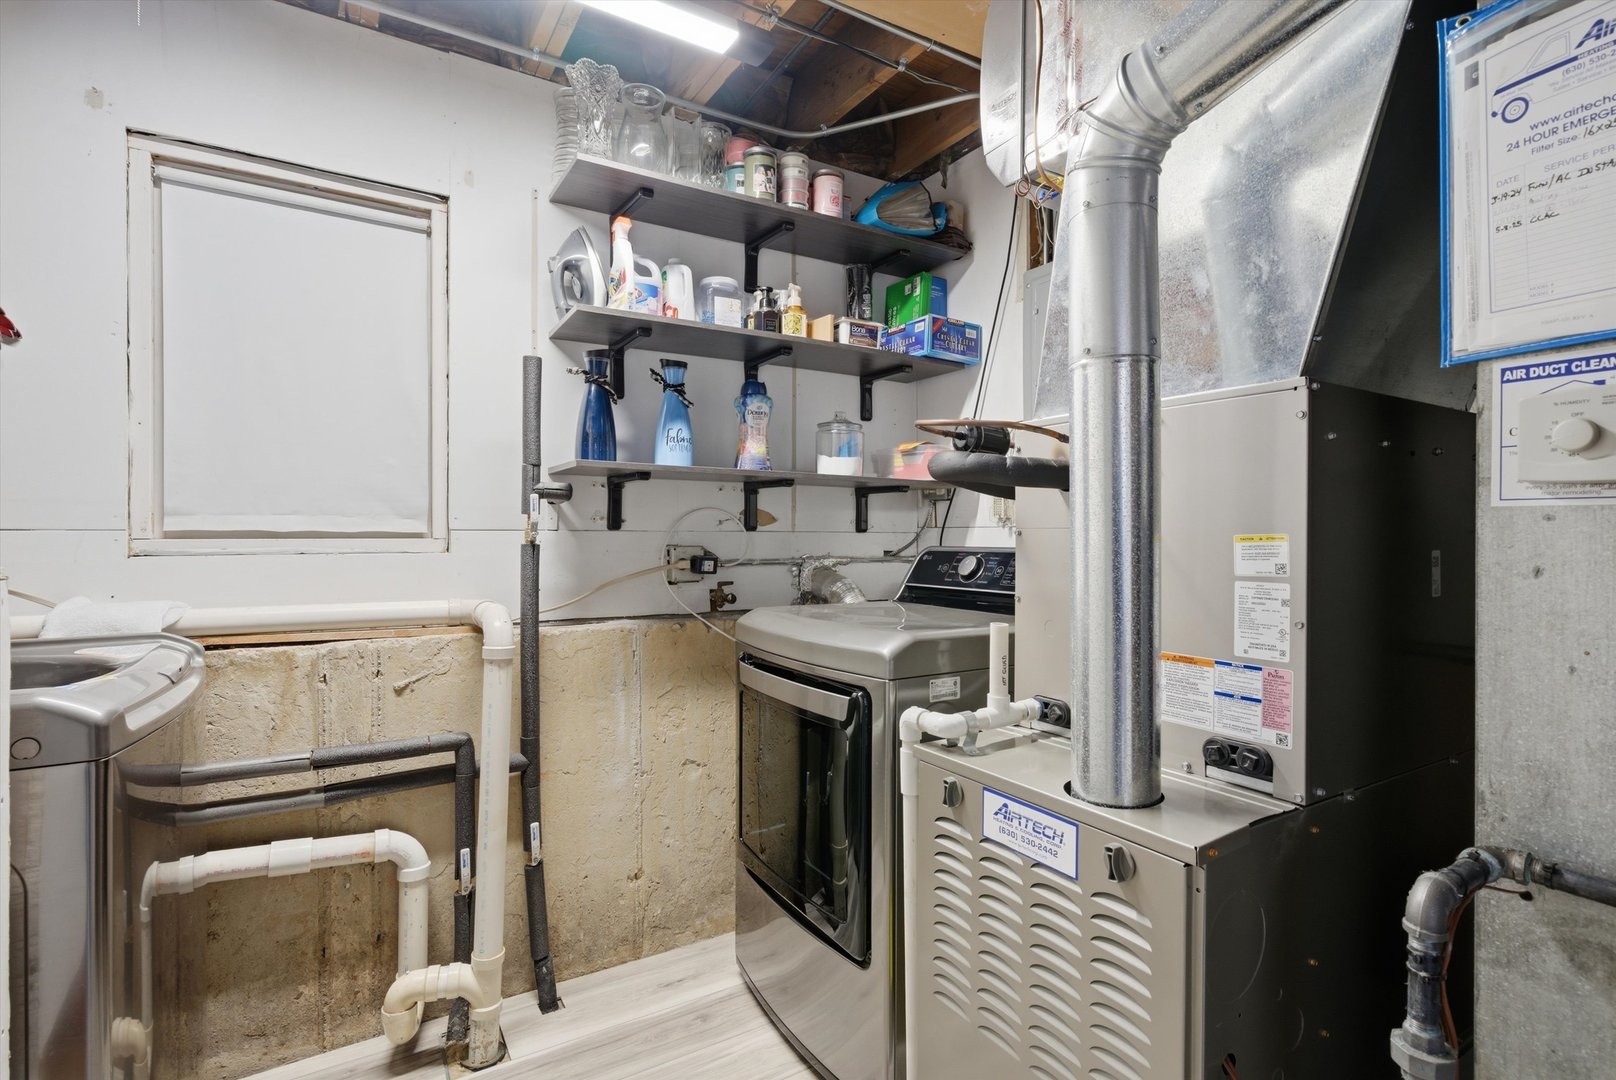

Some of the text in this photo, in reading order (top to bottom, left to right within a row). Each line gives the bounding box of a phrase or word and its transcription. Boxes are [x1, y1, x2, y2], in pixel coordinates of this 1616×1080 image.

[1506, 141, 1520, 153] 24
[1523, 126, 1559, 147] HOUR
[1531, 142, 1554, 156] Filter
[1543, 152, 1589, 173] SERVICE
[1496, 174, 1521, 189] DATE
[851, 325, 866, 333] Bona
[1503, 368, 1526, 381] AIR
[1529, 363, 1568, 377] DUCT
[993, 802, 1064, 844] AIRTECH
[998, 825, 1018, 841] (630)
[1020, 835, 1058, 858] 530-2442
